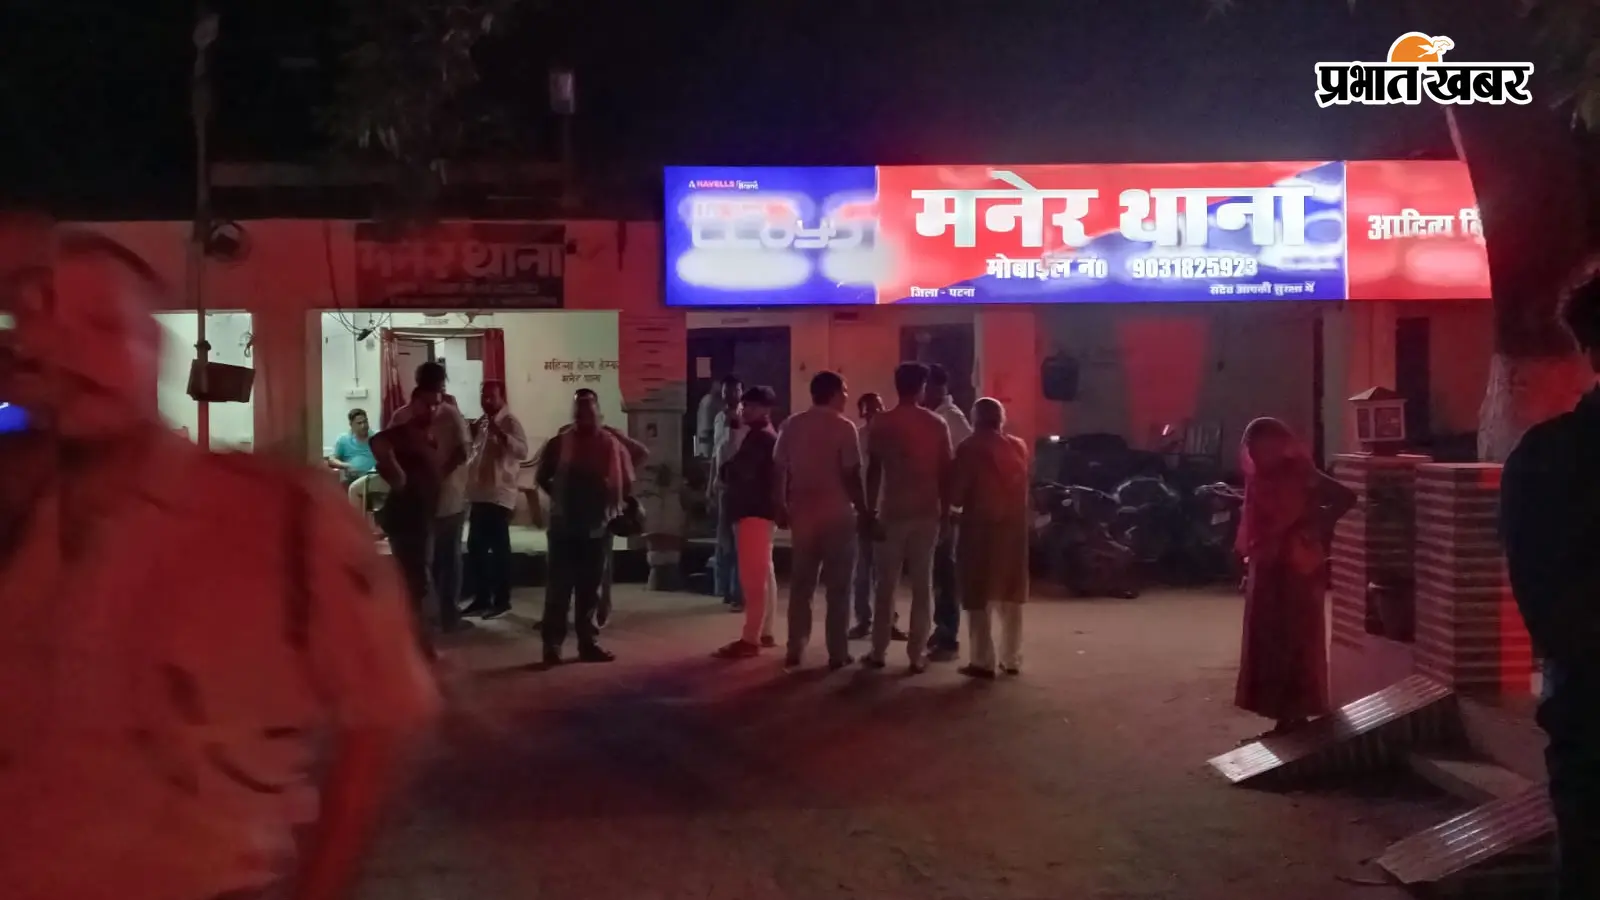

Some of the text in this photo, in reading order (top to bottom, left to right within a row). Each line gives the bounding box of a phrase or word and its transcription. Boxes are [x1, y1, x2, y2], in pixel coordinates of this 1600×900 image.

[911, 170, 1314, 247] मनेर थाना
[461, 238, 565, 279] थाना
[1132, 257, 1258, 279] 9031825923
[910, 286, 939, 298] जिला
[949, 287, 976, 298] पटना
